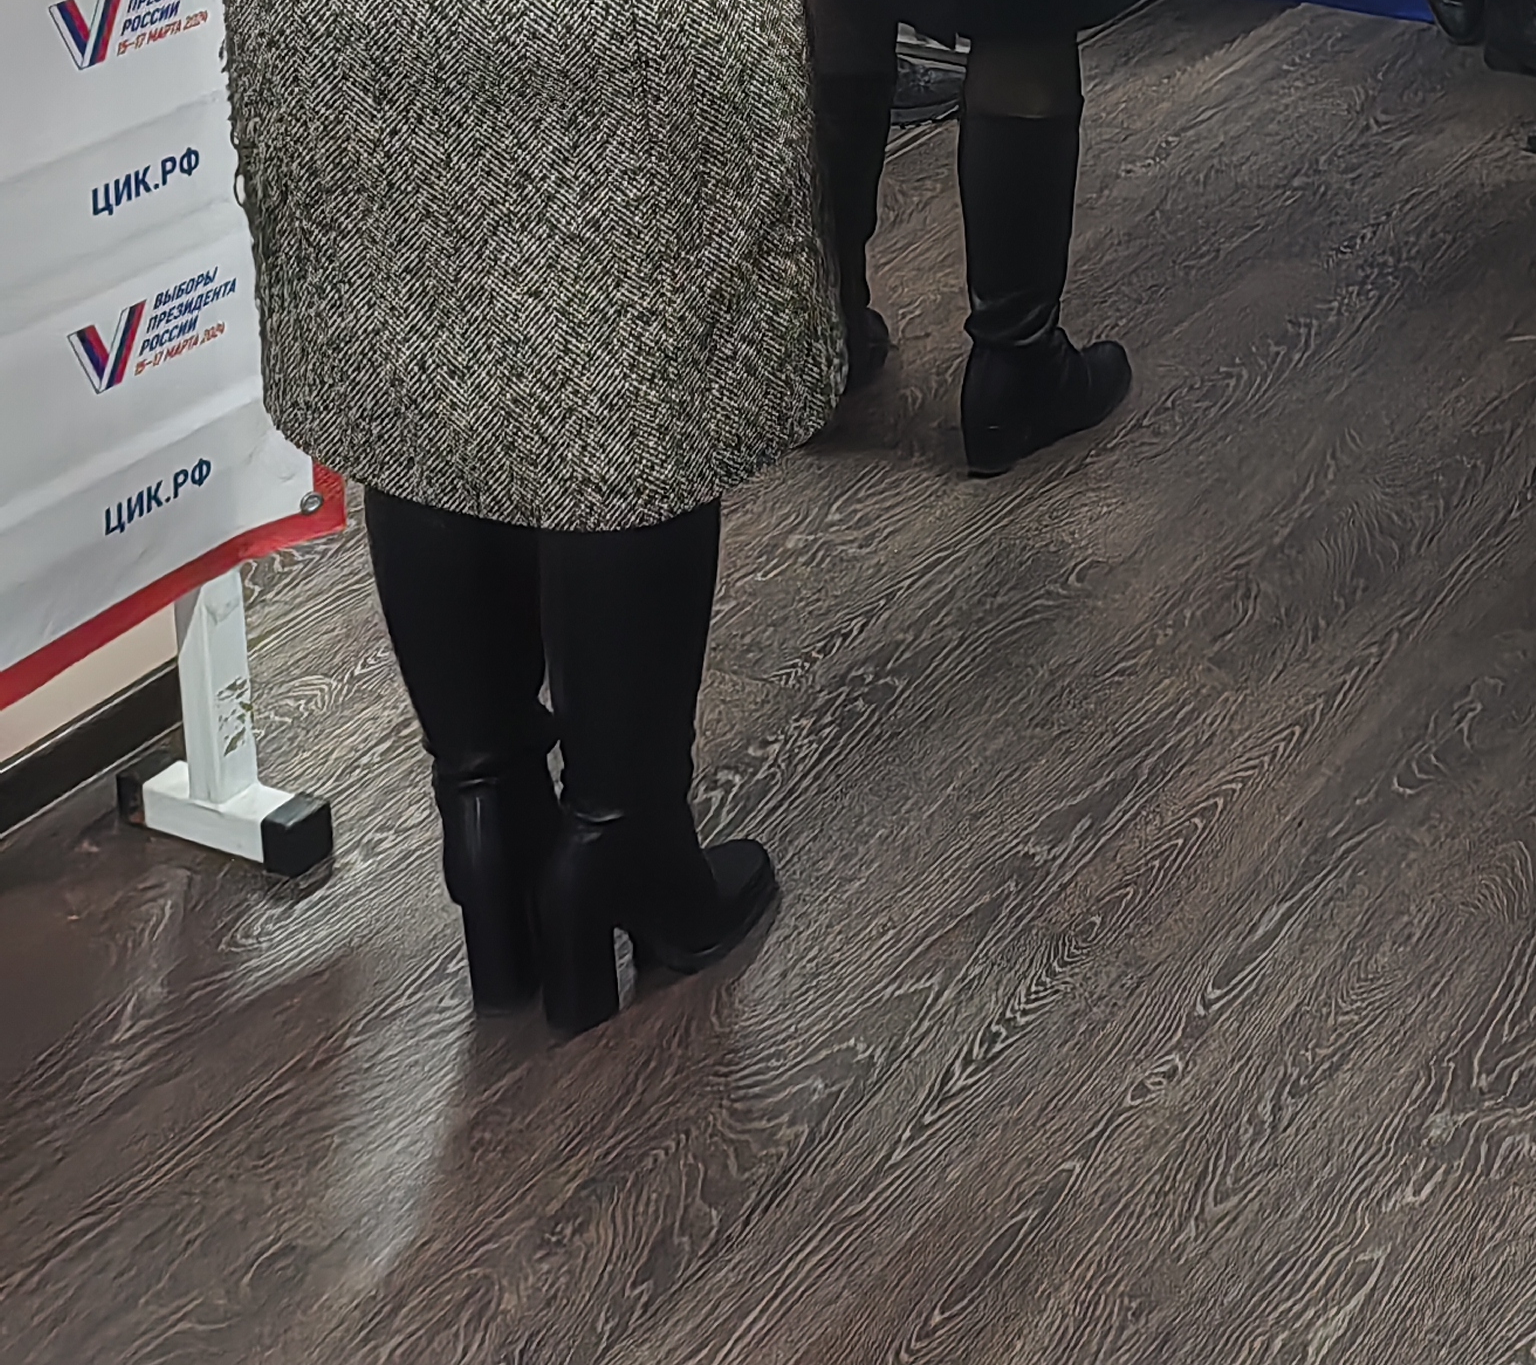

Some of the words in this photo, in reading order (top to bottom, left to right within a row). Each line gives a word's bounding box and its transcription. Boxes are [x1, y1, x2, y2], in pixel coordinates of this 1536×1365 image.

[120, 0, 180, 36] РОССИИ
[147, 19, 182, 45] МАРТА
[183, 10, 208, 31] 2024
[92, 146, 200, 216] ЦИК.РФ
[146, 277, 237, 334] ПРЕЗИДЕНТА
[153, 266, 219, 311] ВЫБОРЫ
[138, 314, 199, 358] РОССИИ
[164, 336, 199, 361] МАРТА
[200, 321, 226, 345] 2024
[105, 457, 212, 536] ЦИК.РФ
